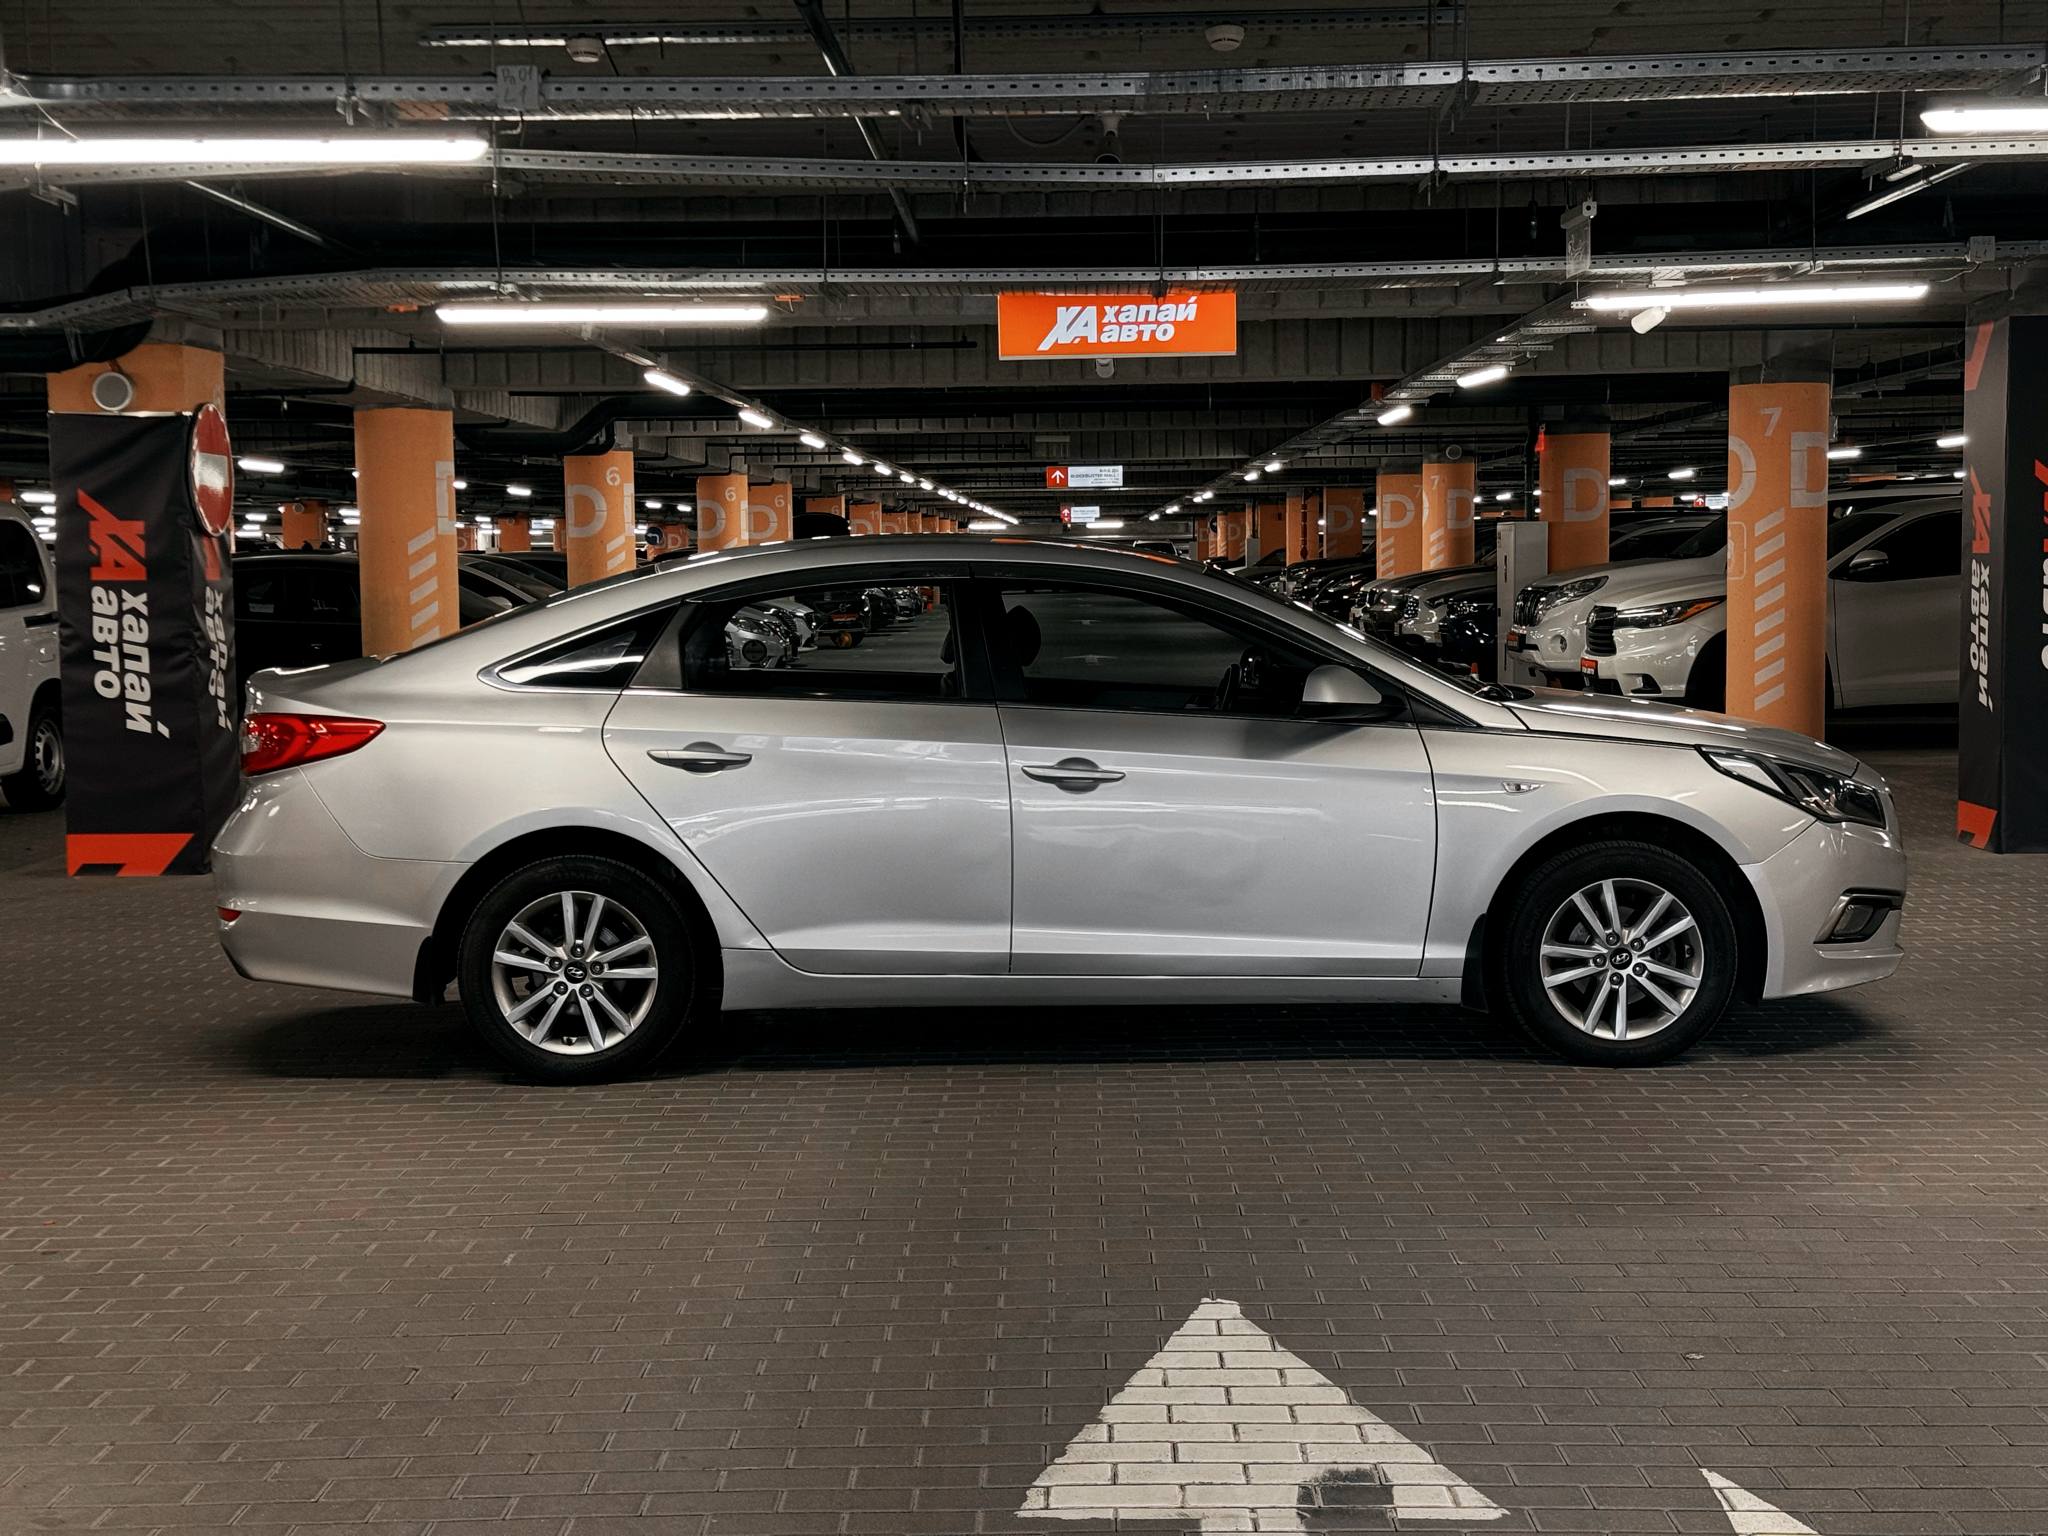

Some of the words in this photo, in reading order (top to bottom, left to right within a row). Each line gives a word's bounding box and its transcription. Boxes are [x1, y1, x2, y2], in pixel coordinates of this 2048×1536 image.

[1101, 295, 1198, 323] хапай
[1100, 323, 1175, 343] авто
[1760, 407, 1782, 437] 7
[606, 466, 621, 487] 6
[1430, 475, 1441, 491] 7
[725, 487, 736, 502] 6
[774, 495, 785, 508] 6
[1447, 488, 1475, 530] D
[1563, 468, 1608, 523] D
[566, 484, 608, 538] D
[697, 501, 726, 540] D
[751, 504, 778, 539] D
[1327, 504, 1355, 534] D
[1382, 493, 1416, 529] D
[667, 533, 682, 549] D
[90, 585, 121, 699] авто
[121, 588, 171, 739] хапай
